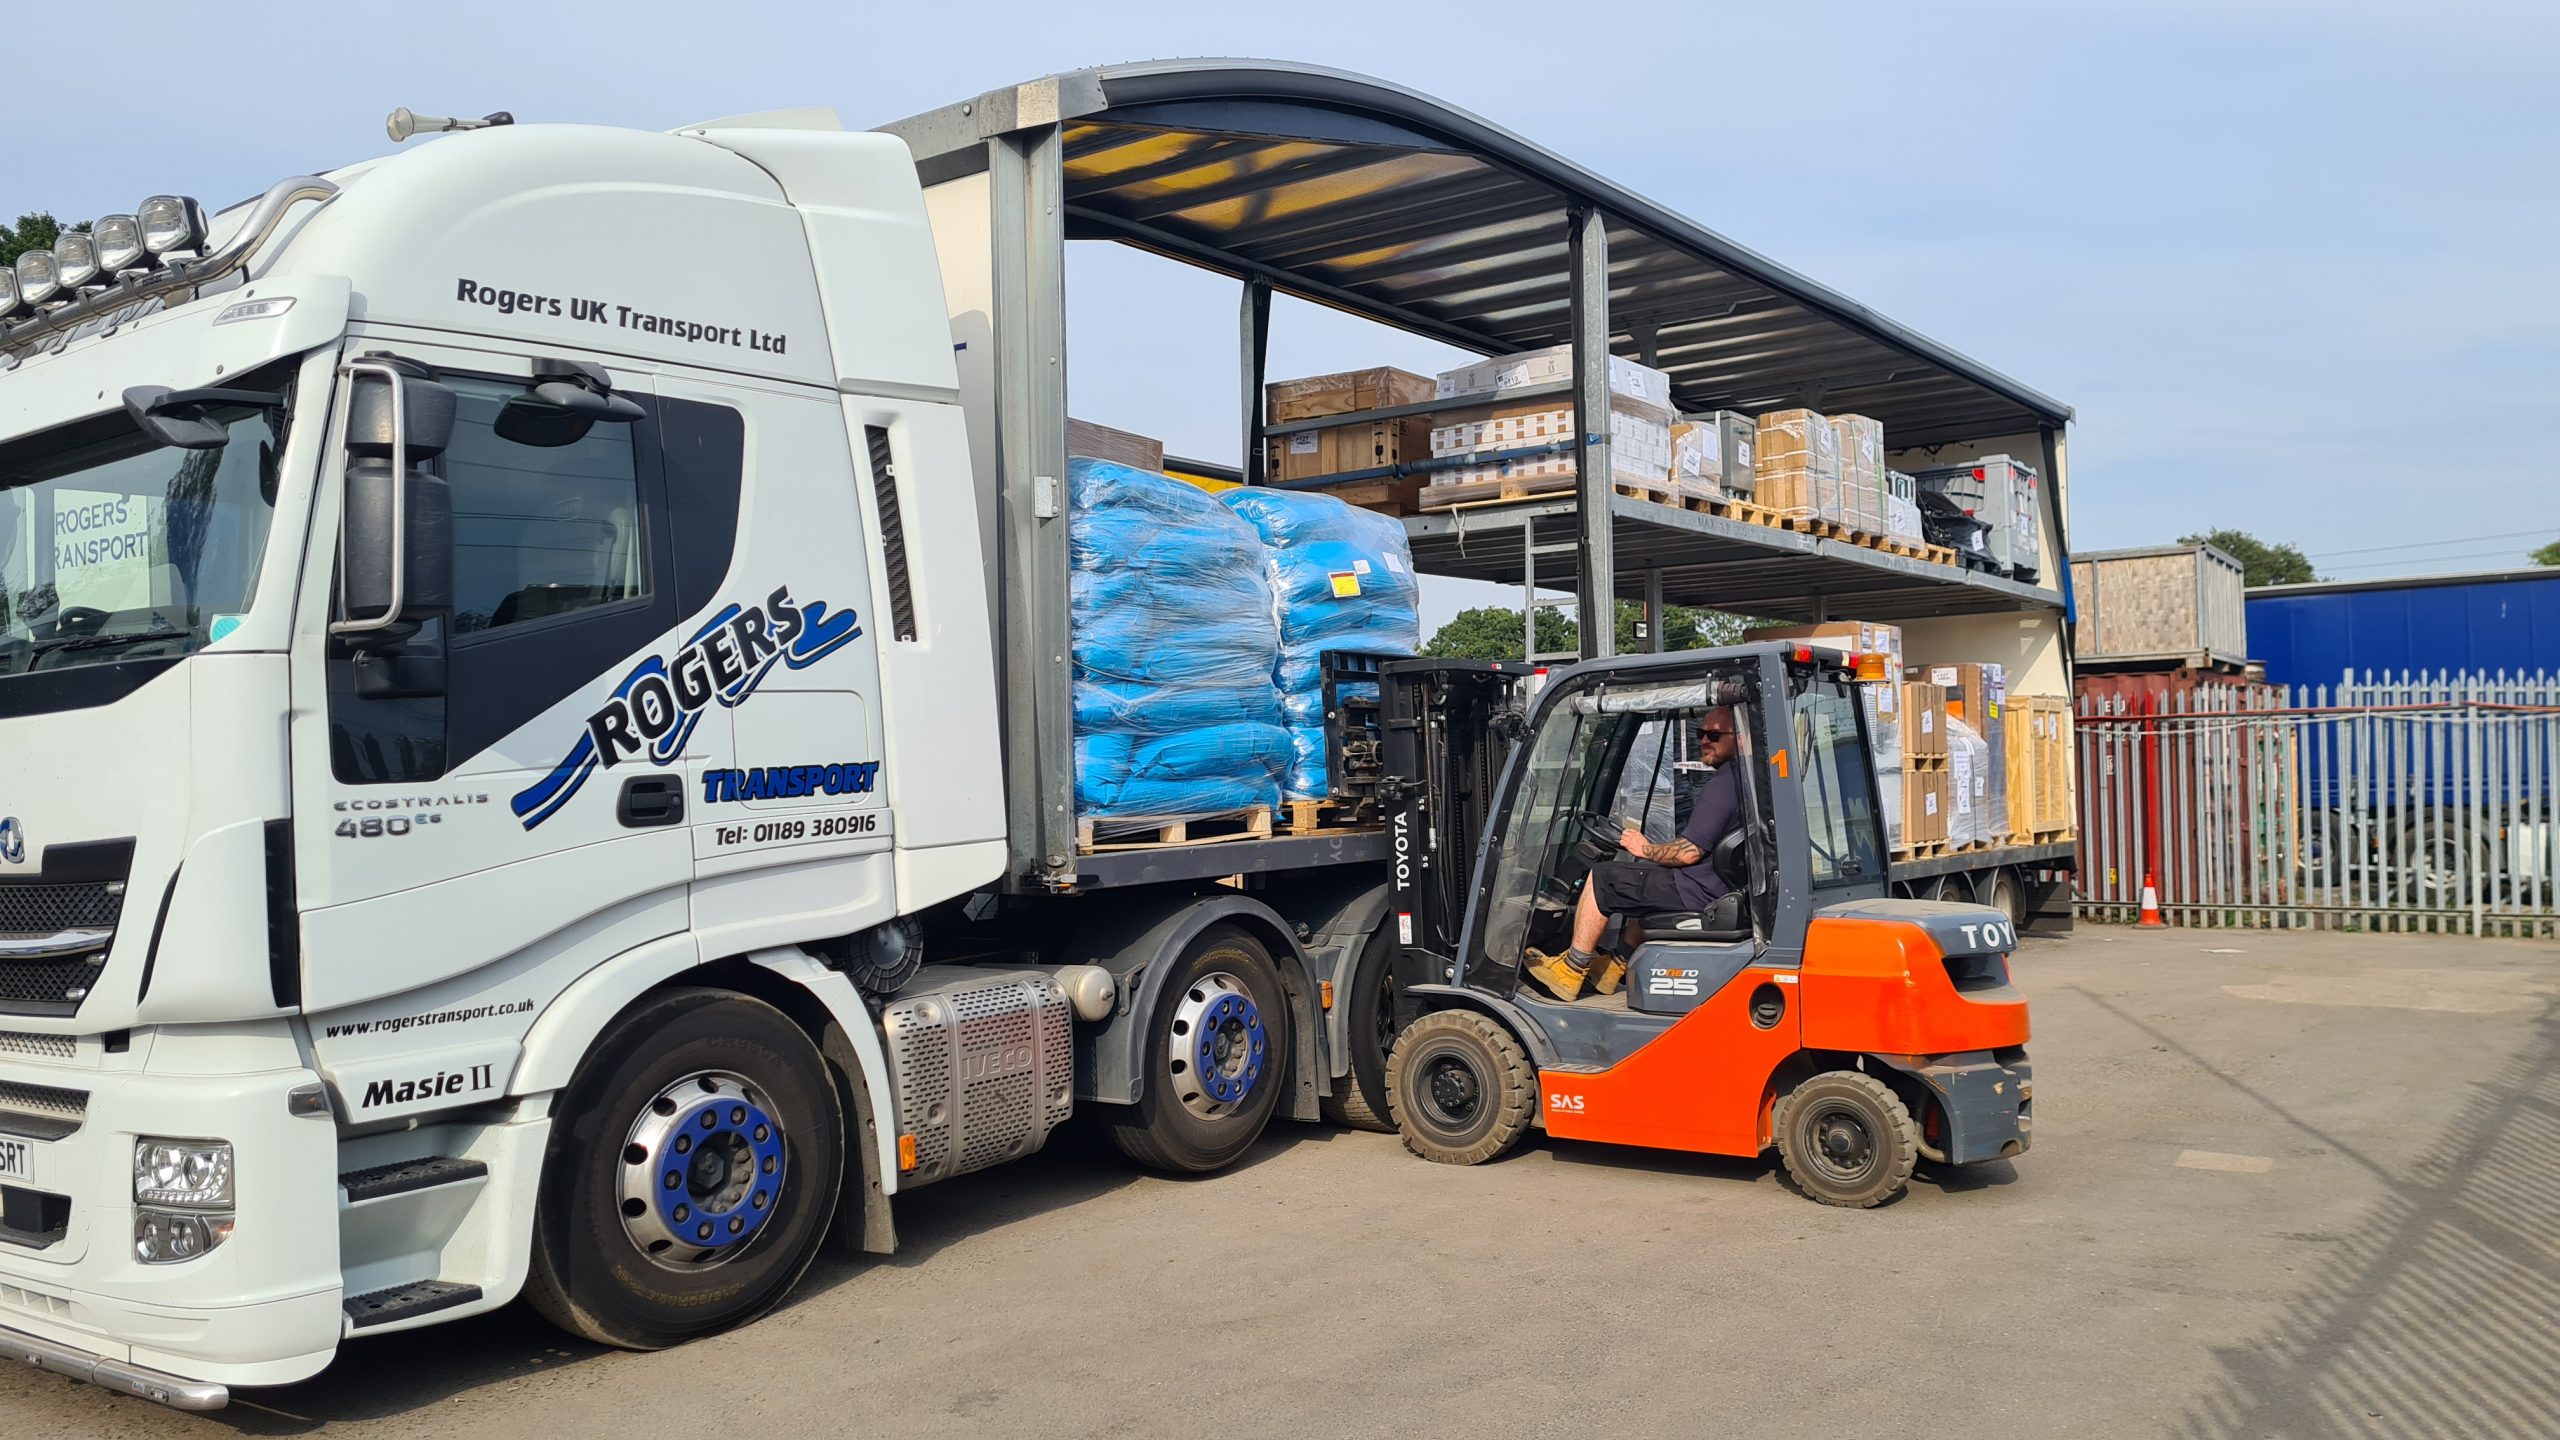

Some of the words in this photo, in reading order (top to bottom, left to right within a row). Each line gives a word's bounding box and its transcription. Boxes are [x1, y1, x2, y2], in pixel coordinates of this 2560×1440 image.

[456, 277, 562, 316] Rogers
[569, 297, 608, 324] UK
[616, 305, 742, 347] Transport
[749, 329, 786, 355] Ltd
[55, 499, 129, 536] ROGERS
[585, 584, 804, 771] ROGERS
[1769, 749, 1789, 778] 1
[701, 760, 880, 803] TRANSPORT
[333, 793, 489, 812] ECOSTRALIS
[334, 815, 411, 838] 480
[715, 825, 748, 846] Tel:
[753, 820, 805, 843] 01189
[810, 814, 877, 839] 380916
[1394, 811, 1411, 892] TOYOTA
[1960, 921, 2017, 949] TOY
[1649, 977, 1699, 996] 25
[326, 998, 535, 1038] www.rogerstransport.co.uk
[961, 1045, 1033, 1080] IVECO
[361, 1071, 465, 1109] Masie
[1550, 1093, 1585, 1110] SAS
